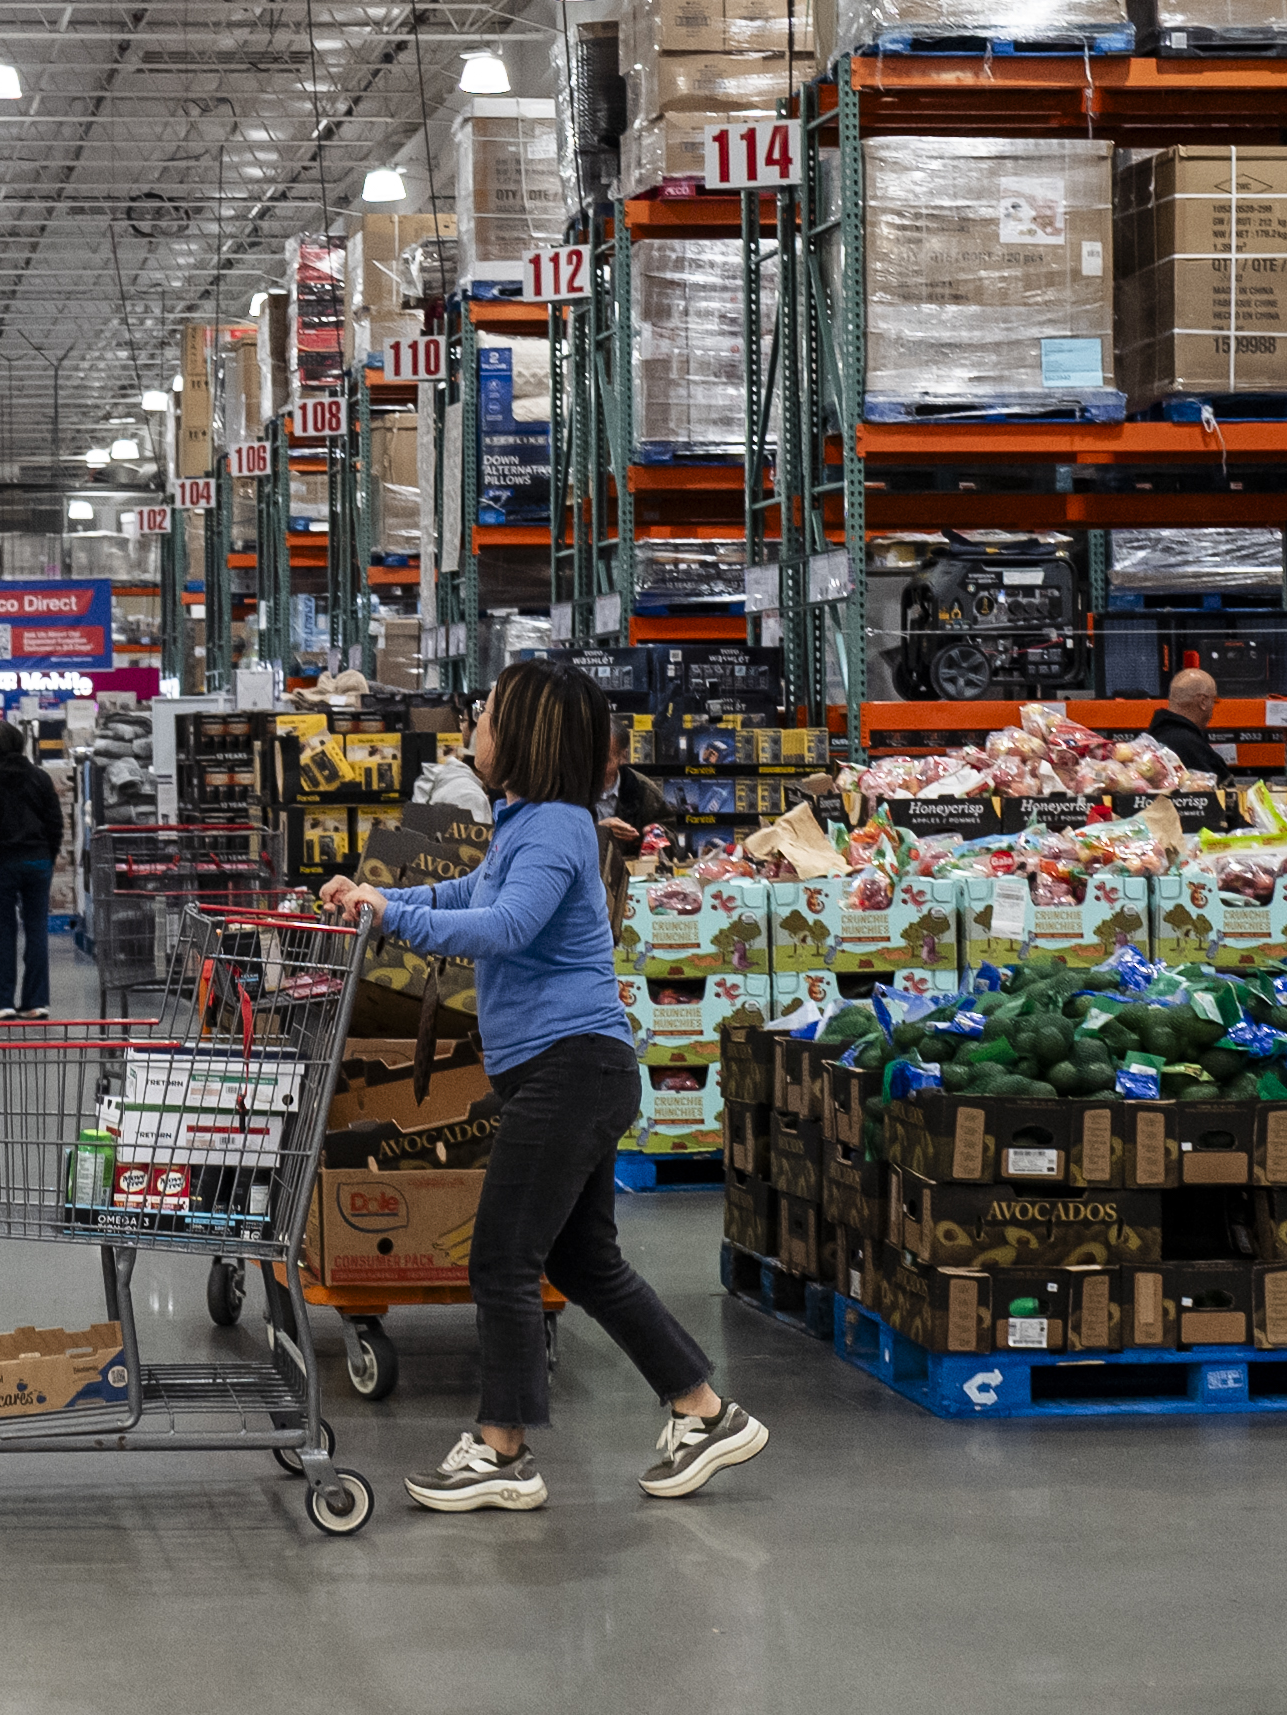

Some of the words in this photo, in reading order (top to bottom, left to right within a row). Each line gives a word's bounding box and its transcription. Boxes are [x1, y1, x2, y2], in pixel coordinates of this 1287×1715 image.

[712, 124, 793, 183] 114
[1251, 258, 1278, 272] QTE
[529, 248, 584, 297] 112
[390, 339, 440, 376] 110
[298, 400, 341, 433] 108
[236, 445, 267, 473] 106
[483, 455, 519, 465] DOWN
[484, 476, 531, 485] PILLOWS
[179, 481, 212, 505] 104
[138, 509, 167, 531] 102
[23, 595, 77, 612] Direct
[1240, 733, 1262, 741] 2032
[909, 802, 984, 817] Honeycrisp
[1020, 798, 1095, 815] Honeycrisp
[990, 857, 1013, 866] Gala
[841, 914, 889, 925] CRUNCHIE
[1034, 910, 1083, 921] CRUNCHIE
[1223, 910, 1271, 921] CRUNCHIE
[651, 920, 699, 931] CRUNCHIE
[841, 925, 890, 935] MUNCHIES
[1034, 921, 1083, 932] MUNCHIES
[1223, 921, 1272, 932] MUNCHIES
[652, 931, 700, 943] MUNCHIES
[653, 1007, 702, 1018] CRUNCHIE
[653, 1018, 702, 1030] MUNCHIES
[654, 1096, 704, 1107] CRUNCHIE
[654, 1107, 704, 1118] MUNCHIES
[380, 1114, 502, 1160] AVOCADOS
[350, 1191, 399, 1212] Dole
[986, 1202, 1118, 1222] AVOCADOS
[98, 1215, 137, 1226] OMEGA
[334, 1255, 400, 1268] CONSUMER
[404, 1254, 434, 1267] PACK
